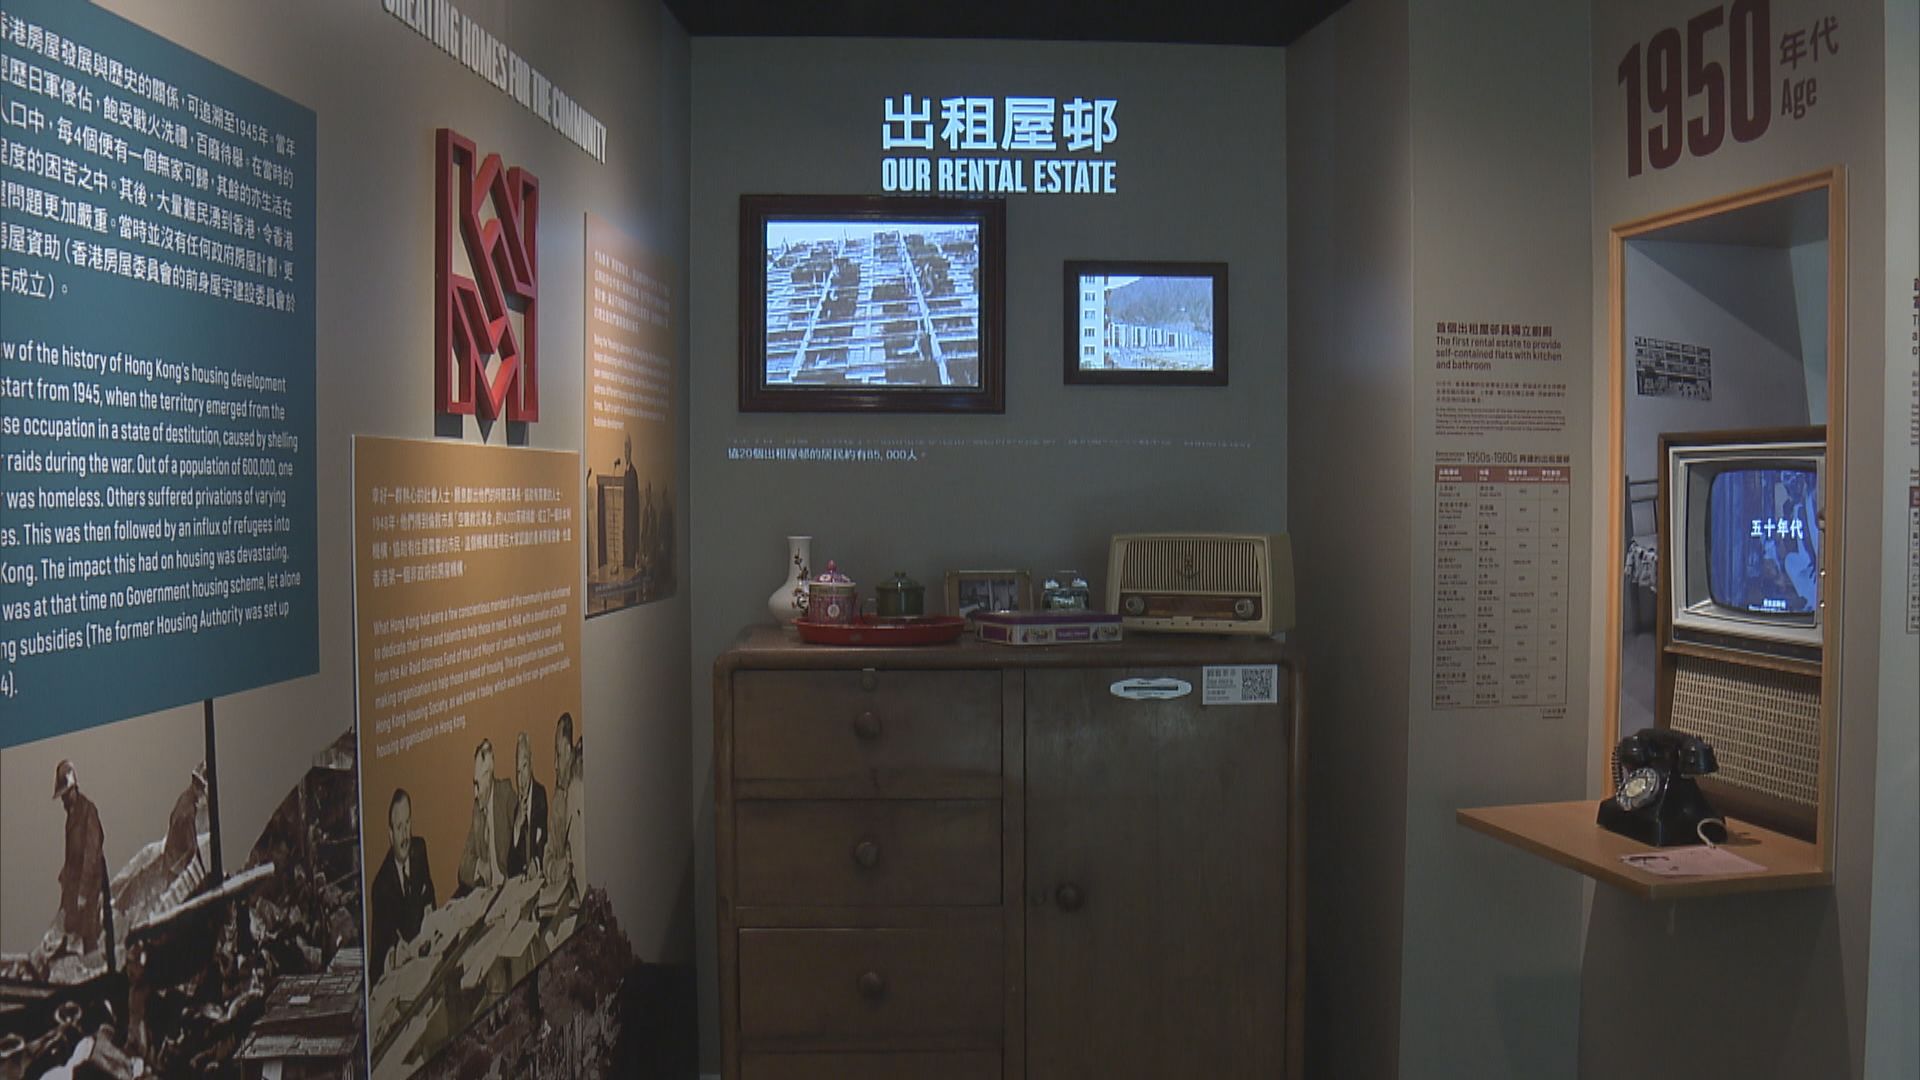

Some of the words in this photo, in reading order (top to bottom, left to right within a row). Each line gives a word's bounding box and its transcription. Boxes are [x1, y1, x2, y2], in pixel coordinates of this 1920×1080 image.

[1780, 16, 1839, 70] 年代
[461, 14, 507, 91] HOMES
[508, 50, 531, 108] FOR
[532, 68, 552, 123] THE
[552, 86, 607, 164] COMMUNITY
[1618, 0, 1771, 179] 1950
[1780, 77, 1817, 120] Age
[882, 94, 1118, 153] 出租屋邨
[882, 157, 931, 192] OUR
[938, 158, 1027, 193] RENTAL
[1034, 159, 1117, 194] ESTATE
[1436, 337, 1450, 347] The
[1452, 337, 1469, 348] first
[1471, 338, 1495, 349] rental
[1496, 340, 1522, 349] estate
[1523, 340, 1531, 349] to
[1532, 340, 1561, 351] provide
[1436, 348, 1494, 360] self-contained
[1495, 349, 1513, 360] flats
[1515, 351, 1532, 361] with
[1533, 351, 1562, 362] kitchen
[18, 339, 33, 362] of
[36, 341, 59, 366] the
[62, 344, 107, 376] history
[109, 352, 122, 373] of
[124, 354, 153, 381] Hong
[155, 358, 190, 384] Kong's
[191, 362, 230, 390] housing
[230, 368, 286, 393] development
[1436, 360, 1451, 370] and
[1452, 361, 1492, 371] bathroom
[37, 377, 70, 402] from
[73, 381, 103, 407] 1945,
[105, 385, 137, 408] when
[139, 388, 158, 409] the
[159, 391, 205, 418] territory
[205, 399, 247, 420] emerged
[248, 399, 270, 419] from
[271, 402, 285, 421] the
[0, 415, 20, 435] se
[23, 416, 96, 441] occupation
[97, 417, 110, 439] in
[111, 423, 119, 440] a
[120, 422, 151, 442] state
[152, 422, 164, 442] of
[165, 423, 222, 446] destitution,
[222, 428, 255, 447] caused
[256, 429, 267, 451] by
[267, 430, 299, 454] shelling
[7, 449, 42, 472] raids
[45, 450, 86, 478] during
[88, 451, 109, 473] the
[110, 457, 135, 474] war.
[136, 453, 156, 474] Out
[157, 454, 169, 474] of
[171, 459, 178, 475] a
[179, 455, 230, 479] population
[231, 457, 241, 476] of
[242, 457, 277, 477] 600,000,
[278, 461, 293, 477] one
[6, 491, 35, 509] was
[38, 486, 104, 508] homeless.
[106, 486, 146, 507] Others
[147, 485, 194, 507] suffered
[195, 486, 243, 510] privations
[243, 486, 254, 505] of
[254, 486, 287, 508] varying
[23, 521, 52, 545] This
[54, 525, 81, 544] was
[83, 520, 112, 542] then
[114, 518, 162, 540] followed
[164, 518, 177, 542] by
[178, 521, 191, 538] an
[192, 516, 221, 537] influx
[221, 515, 232, 536] of
[233, 515, 273, 538] refugees
[273, 514, 291, 532] into
[1750, 518, 1804, 539] 五十年代
[40, 558, 65, 580] The
[68, 555, 111, 581] impact
[113, 552, 136, 574] this
[138, 551, 159, 572] had
[160, 553, 174, 570] on
[176, 547, 215, 570] housing
[216, 549, 236, 565] was
[236, 543, 288, 564] devastating.
[2, 601, 31, 621] was
[33, 596, 48, 618] at
[50, 593, 77, 616] that
[80, 589, 107, 612] time
[109, 591, 124, 608] no
[126, 581, 190, 606] Government
[191, 577, 229, 599] housing
[230, 575, 266, 594] scheme,
[267, 571, 279, 589] let
[279, 570, 301, 588] alone
[20, 627, 83, 656] subsidies
[85, 622, 113, 649] (The
[115, 619, 154, 641] former
[156, 611, 198, 635] Housing
[199, 604, 244, 628] Authority
[244, 605, 263, 621] was
[263, 601, 278, 618] set
[278, 601, 290, 620] up
